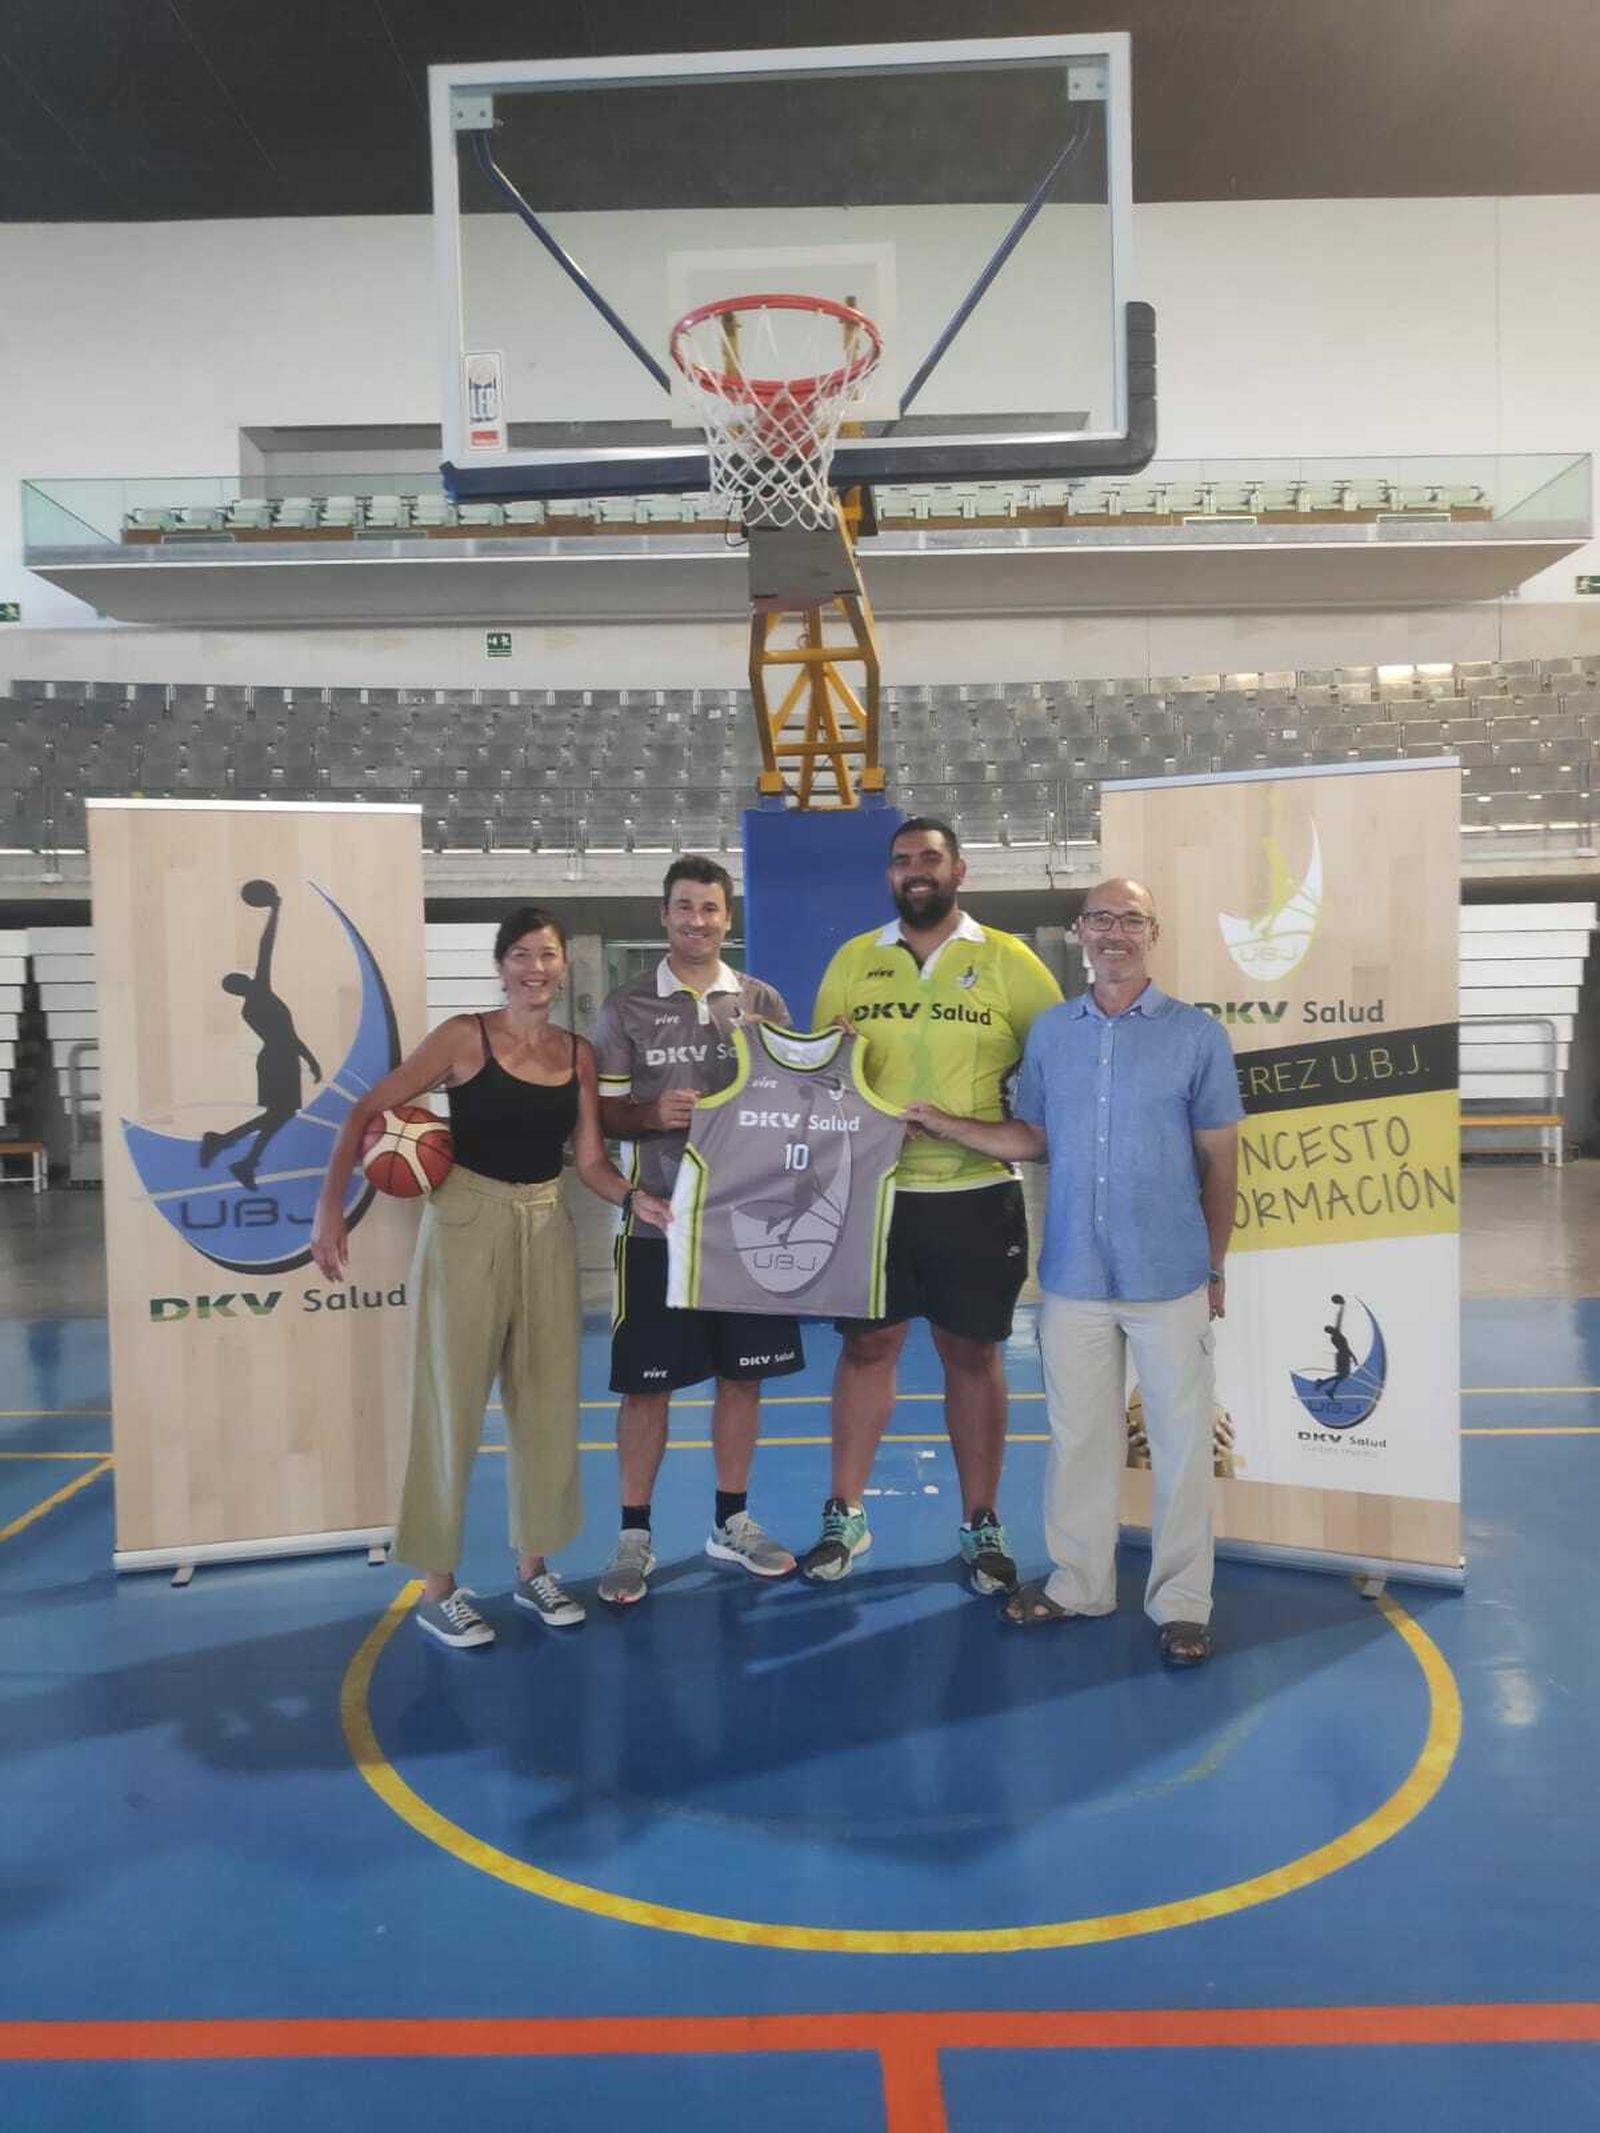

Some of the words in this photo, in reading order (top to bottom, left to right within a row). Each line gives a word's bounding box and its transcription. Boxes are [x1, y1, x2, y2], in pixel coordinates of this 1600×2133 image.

[853, 1002, 921, 1021] DKV
[930, 1003, 992, 1026] Salud
[1302, 1000, 1384, 1024] Salud
[645, 1044, 708, 1067] DKV
[1331, 1044, 1430, 1084] U.B.J.
[739, 1110, 801, 1128] DKV
[808, 1114, 860, 1132] Salud
[784, 1143, 809, 1171] 10
[1241, 1115, 1411, 1176] NCESTO
[753, 1252, 817, 1271] UBJ
[149, 1291, 282, 1322] DKV
[303, 1284, 407, 1313] Salud
[739, 1355, 771, 1366] DKV
[1297, 1431, 1342, 1443] DKV
[1349, 1435, 1387, 1448] Salud
